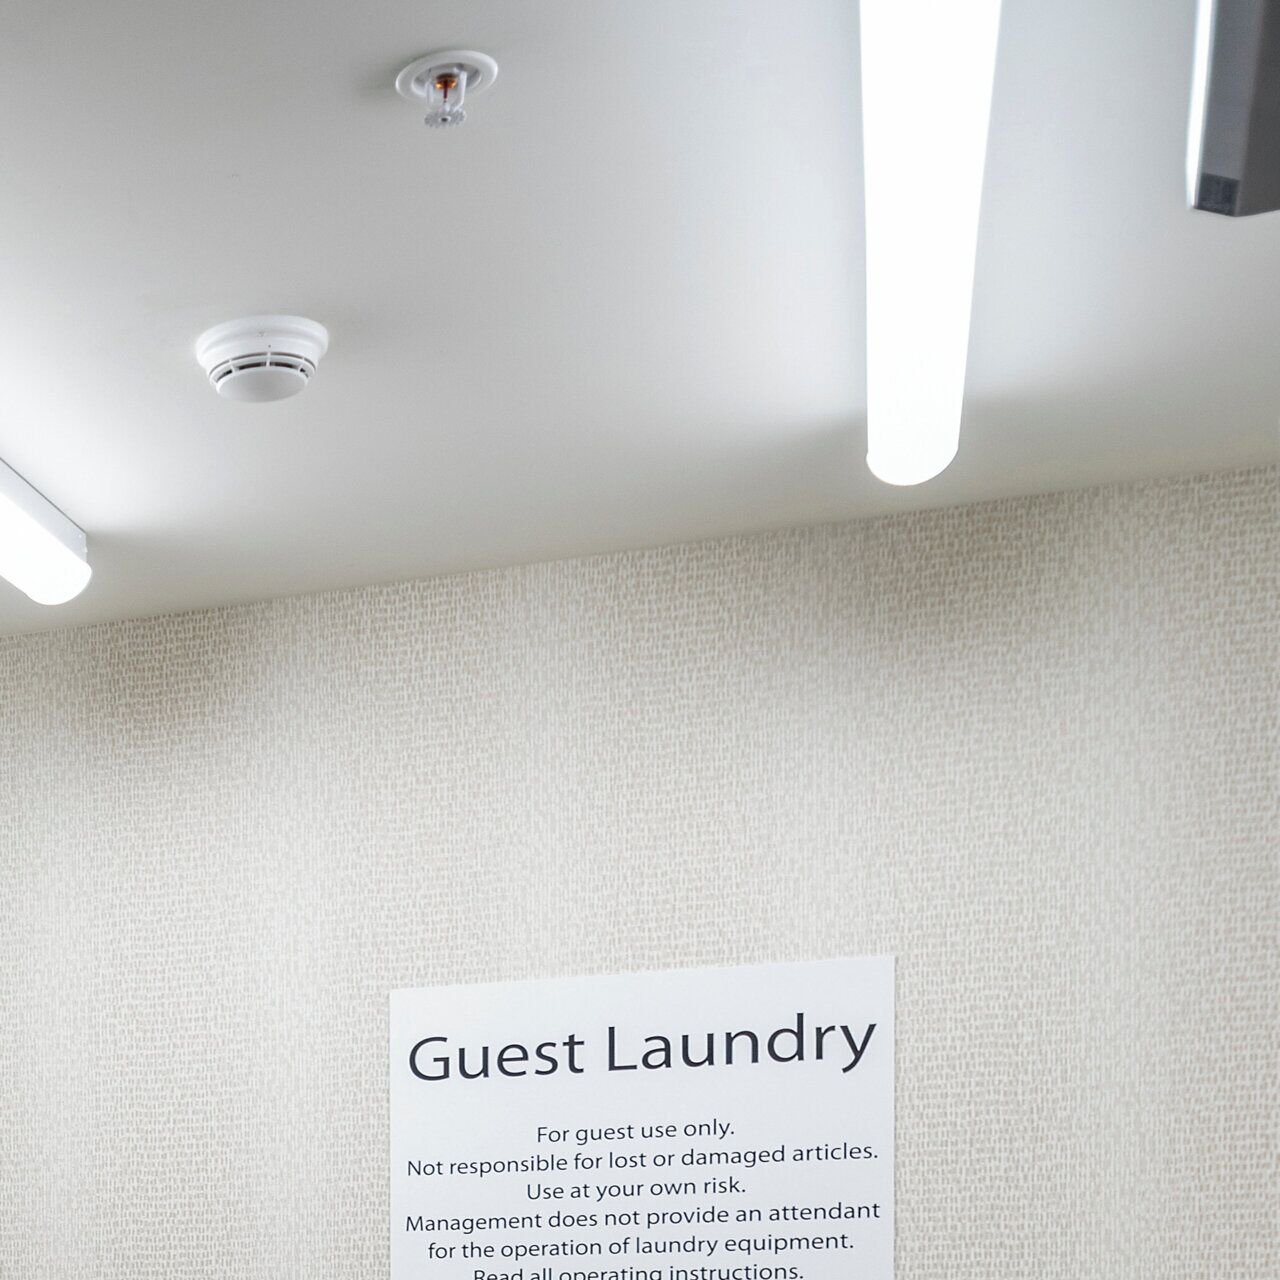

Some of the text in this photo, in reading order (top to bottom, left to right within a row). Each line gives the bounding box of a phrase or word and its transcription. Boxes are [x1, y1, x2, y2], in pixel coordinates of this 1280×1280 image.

[409, 1012, 877, 1081] Guest Laundry
[537, 1118, 735, 1146] For guest use only.
[407, 1142, 878, 1178] Not responsible for lost or damaged articles.
[527, 1175, 746, 1203] Use at your own risk.
[406, 1201, 881, 1235] Management does not provide an attendant
[428, 1234, 854, 1262] for the operation of laundry equipment.
